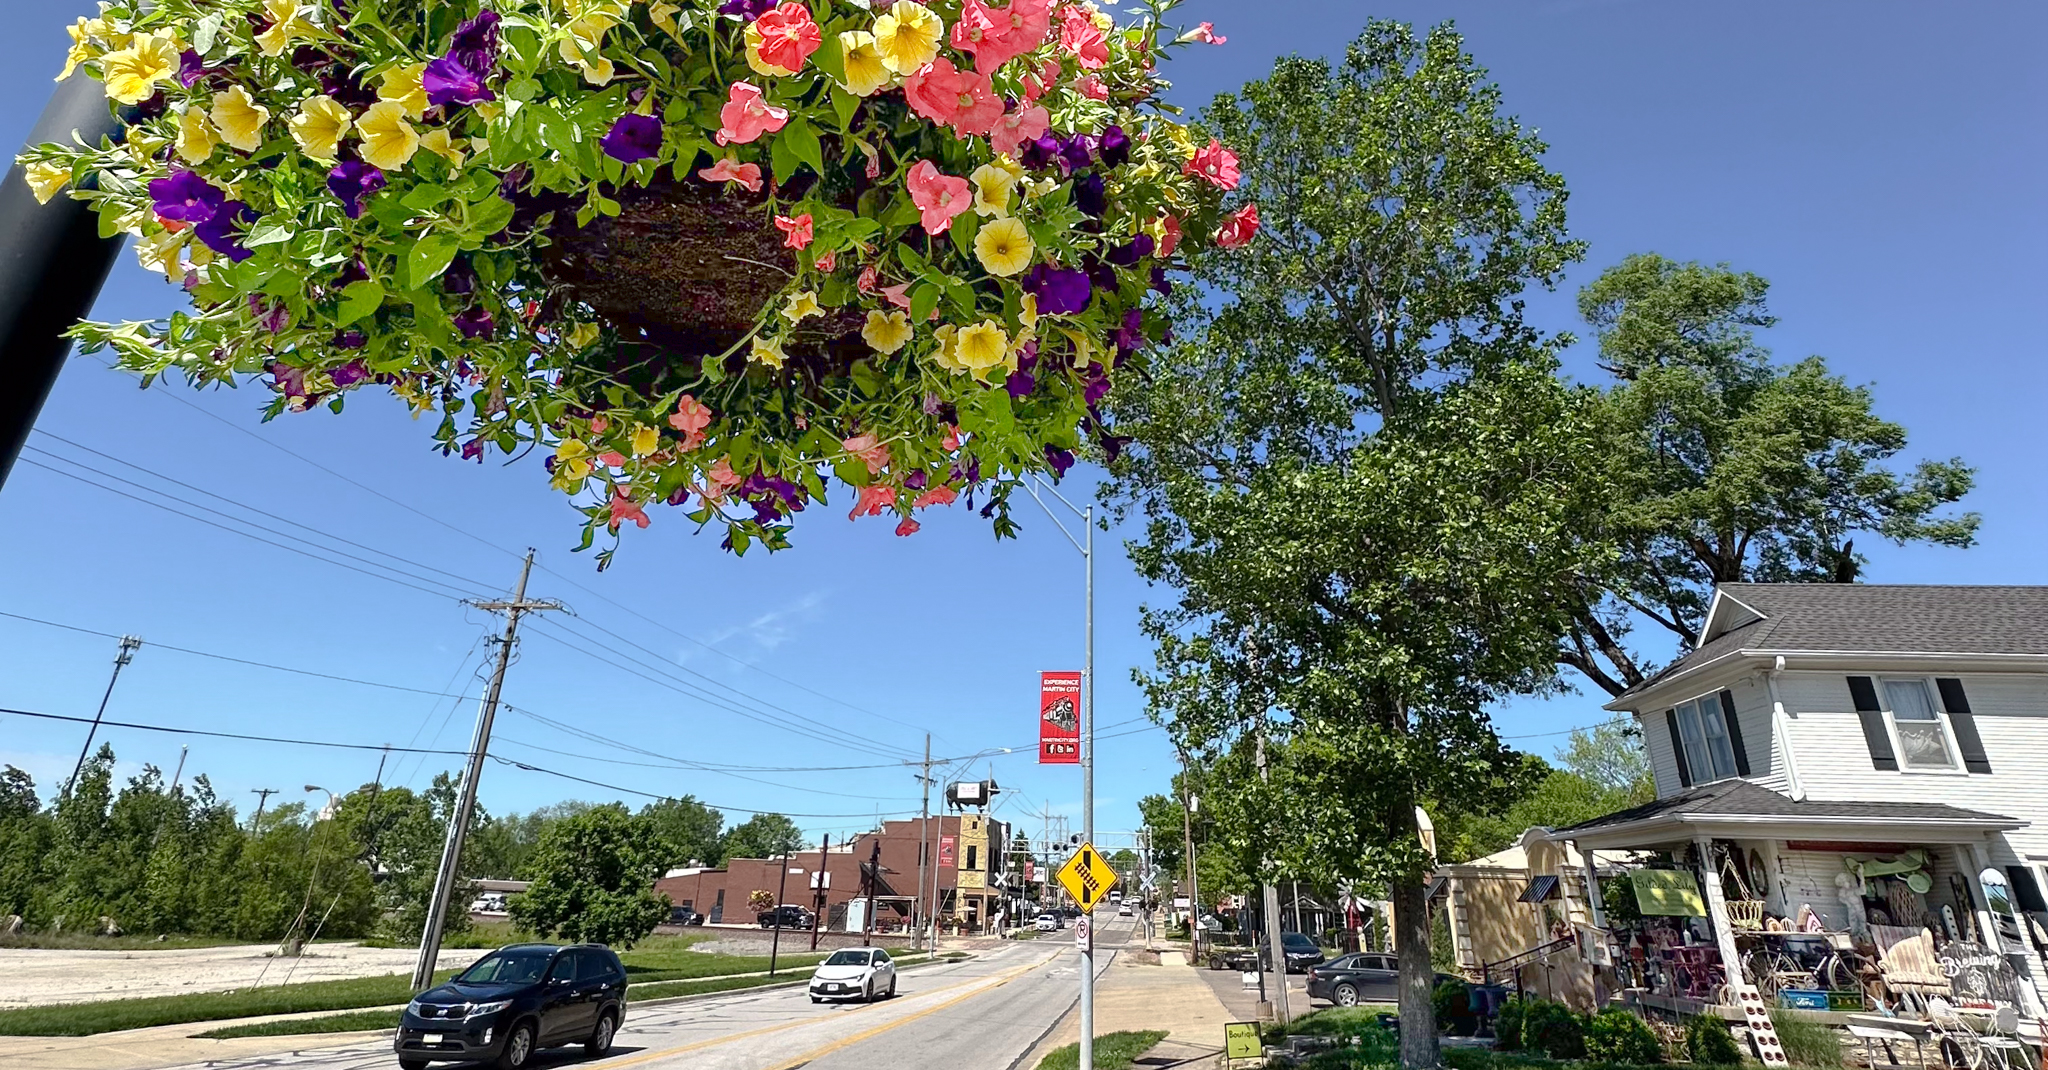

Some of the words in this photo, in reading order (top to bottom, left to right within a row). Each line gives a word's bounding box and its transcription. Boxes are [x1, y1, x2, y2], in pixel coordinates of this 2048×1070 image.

[1673, 876, 1697, 895] Lily
[1960, 943, 1978, 951] THE
[1940, 953, 2001, 977] Brewing
[1796, 997, 1815, 1006] Ford
[1229, 1030, 1258, 1039] Boutique
